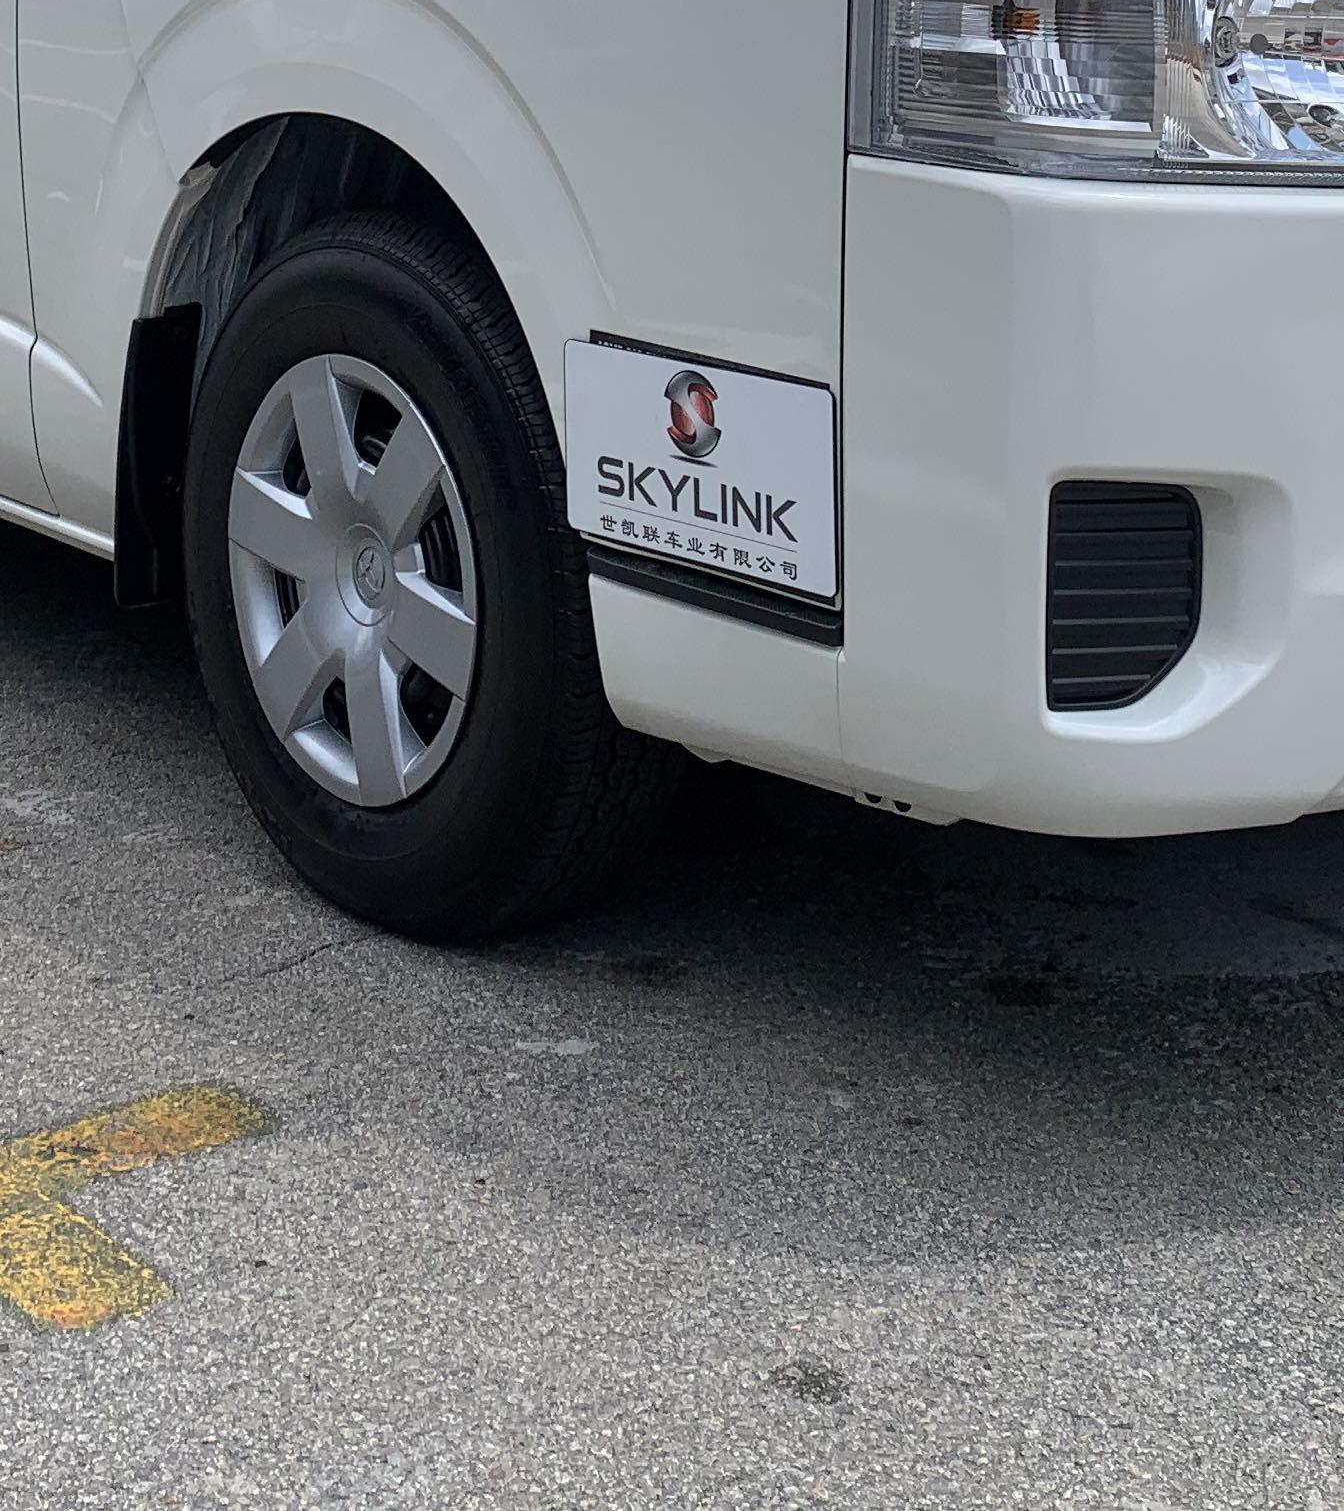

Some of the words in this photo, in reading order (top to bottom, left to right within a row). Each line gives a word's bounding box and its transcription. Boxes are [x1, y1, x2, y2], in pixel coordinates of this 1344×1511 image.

[597, 455, 799, 544] SKYLINK
[599, 513, 799, 581] 世凯联车业有限公司
